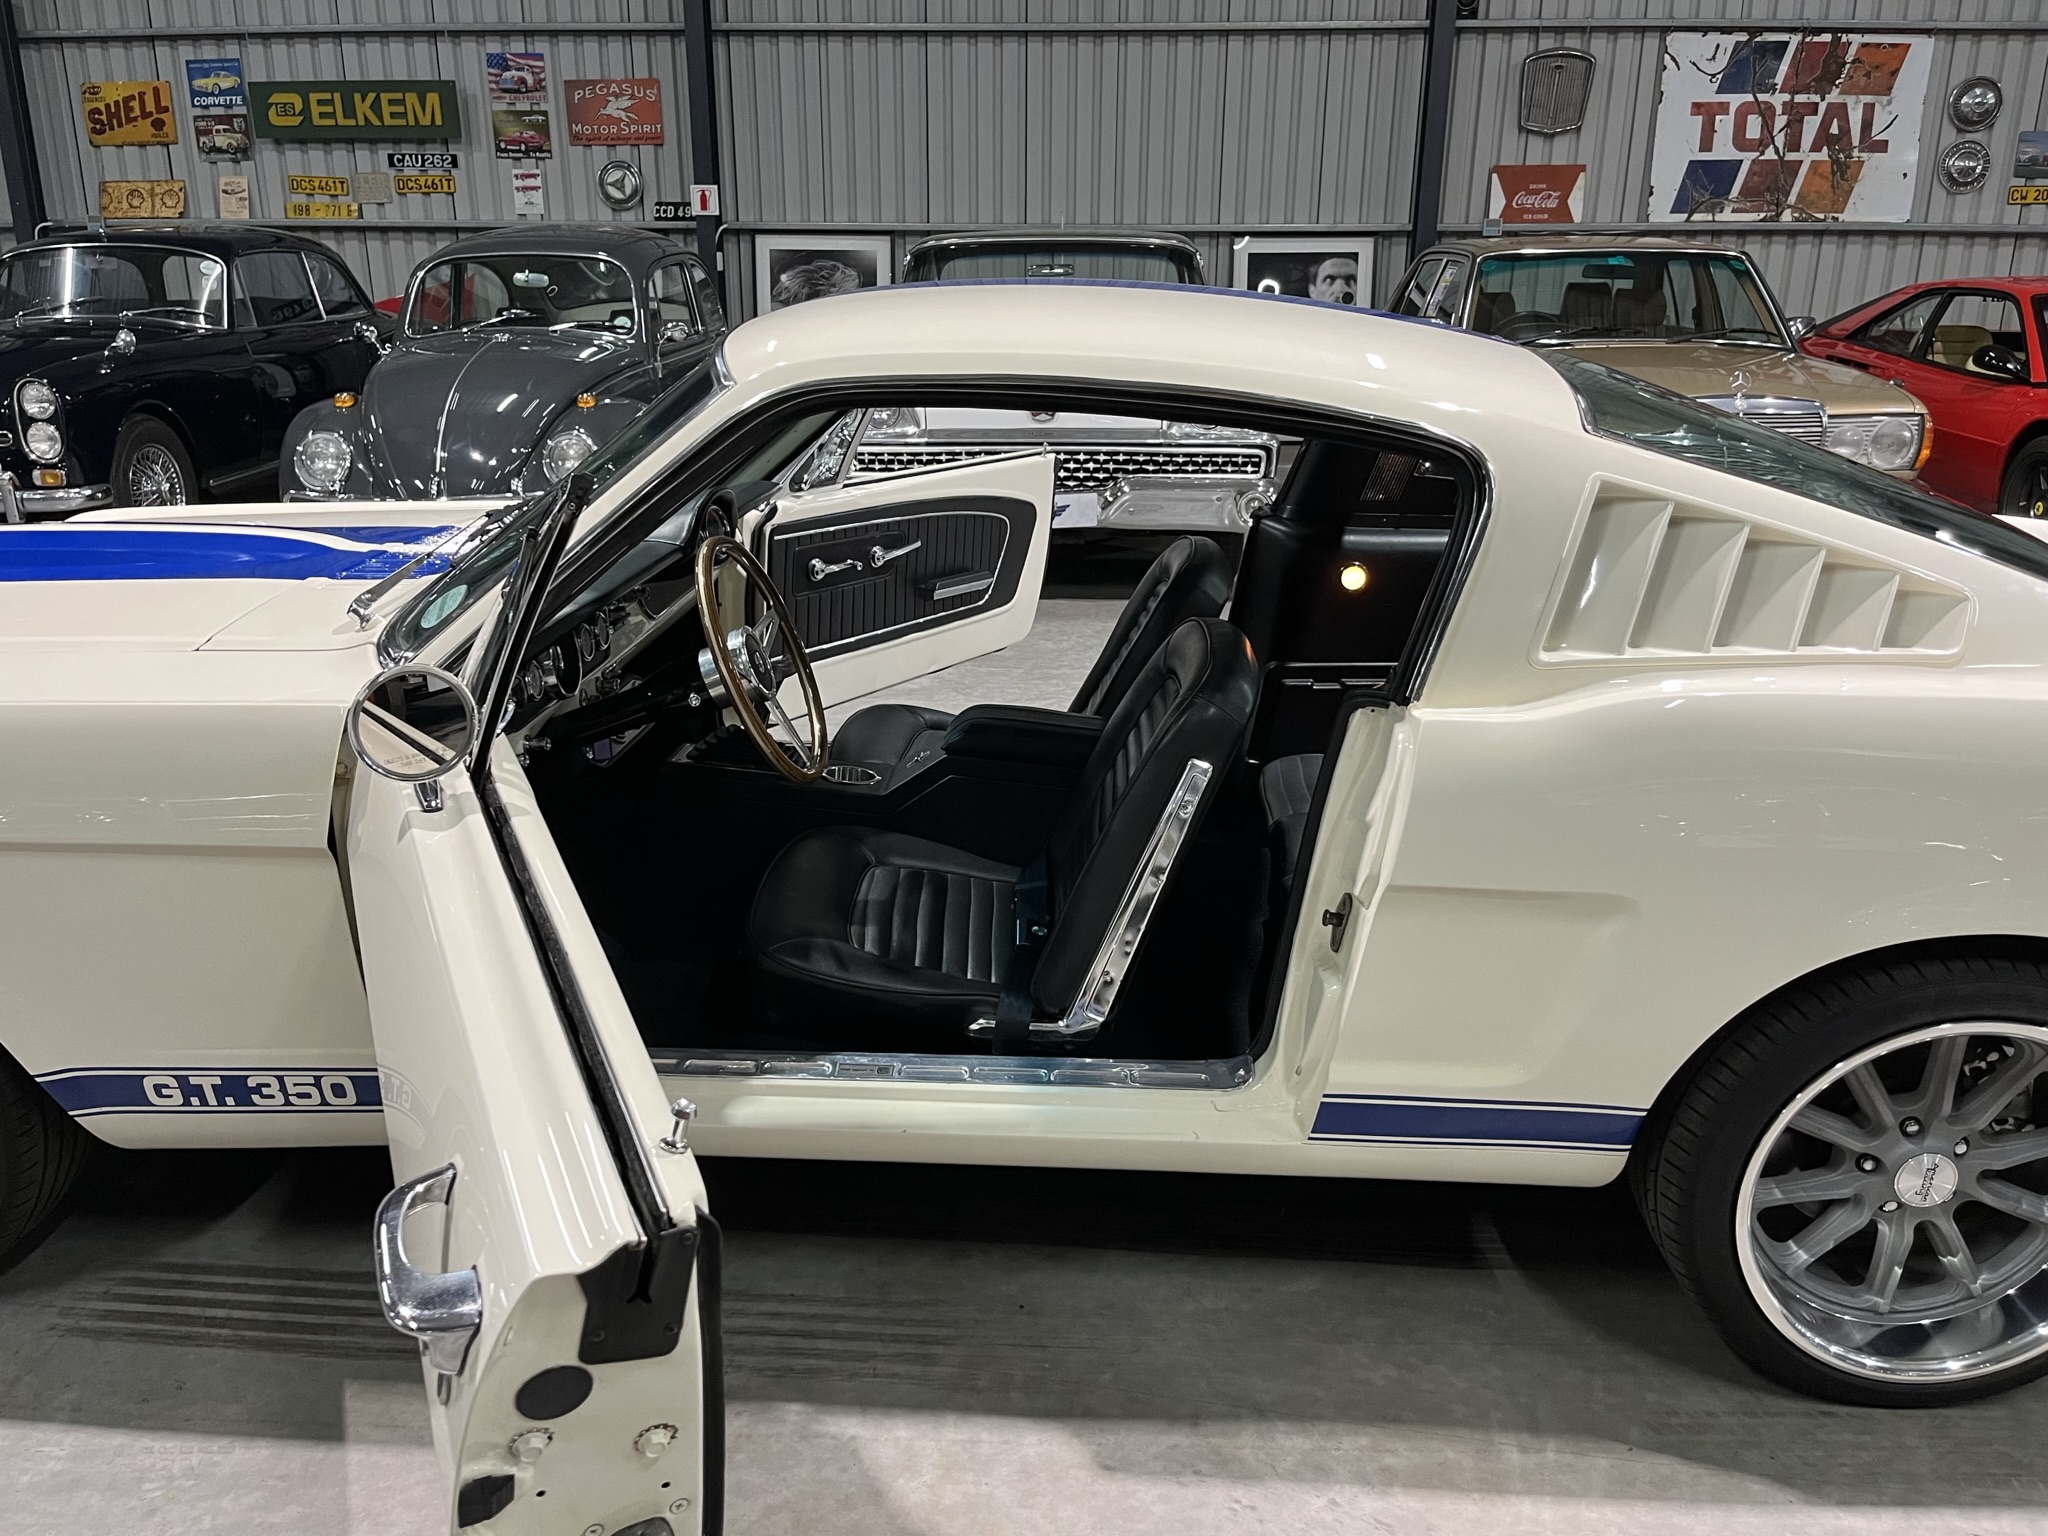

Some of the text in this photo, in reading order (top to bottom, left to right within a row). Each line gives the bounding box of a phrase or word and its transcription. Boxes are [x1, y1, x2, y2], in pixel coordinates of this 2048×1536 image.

[193, 95, 243, 106] CORVETTE
[508, 94, 546, 103] CHEVROLET
[574, 83, 657, 104] PEGASUS
[88, 86, 169, 136] SHELL
[276, 103, 295, 116] ES
[308, 92, 443, 127] ELKEM
[572, 122, 662, 135] MOTOR SPIRIT
[1690, 100, 1889, 154] TOTAL
[585, 135, 601, 143] spirit
[393, 154, 453, 168] CAU 262
[1512, 190, 1561, 208] Coca-Cola
[2011, 188, 2029, 202] CW
[293, 204, 311, 217] 198
[653, 205, 675, 218] CCD
[142, 1074, 357, 1106] G.T. 350
[1921, 1162, 1940, 1202] American
